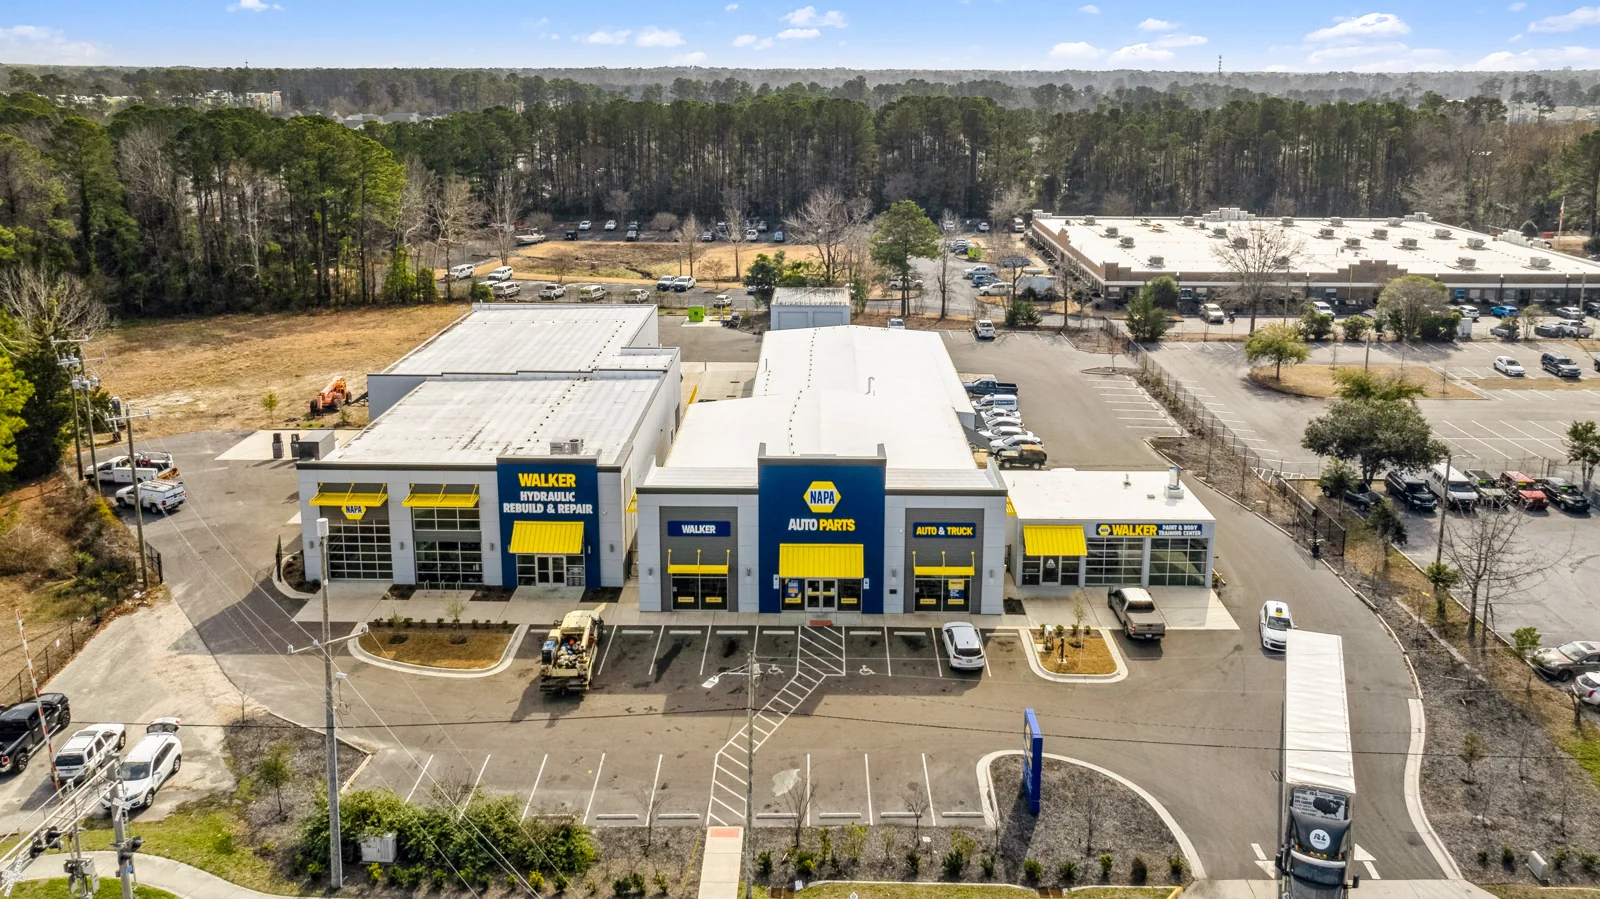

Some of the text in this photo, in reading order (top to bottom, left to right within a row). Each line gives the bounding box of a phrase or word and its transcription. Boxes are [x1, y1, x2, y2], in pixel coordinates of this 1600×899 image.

[518, 473, 576, 487] WALKER
[520, 491, 575, 501] HYDRAULIC
[810, 491, 835, 504] NAPA
[503, 503, 593, 514] REBUILD & REPAIR
[681, 524, 716, 534] WALKER
[787, 518, 855, 531] AUTO PARTS
[1111, 524, 1157, 536] WALKER
[916, 526, 974, 536] AUTO & TRUCK
